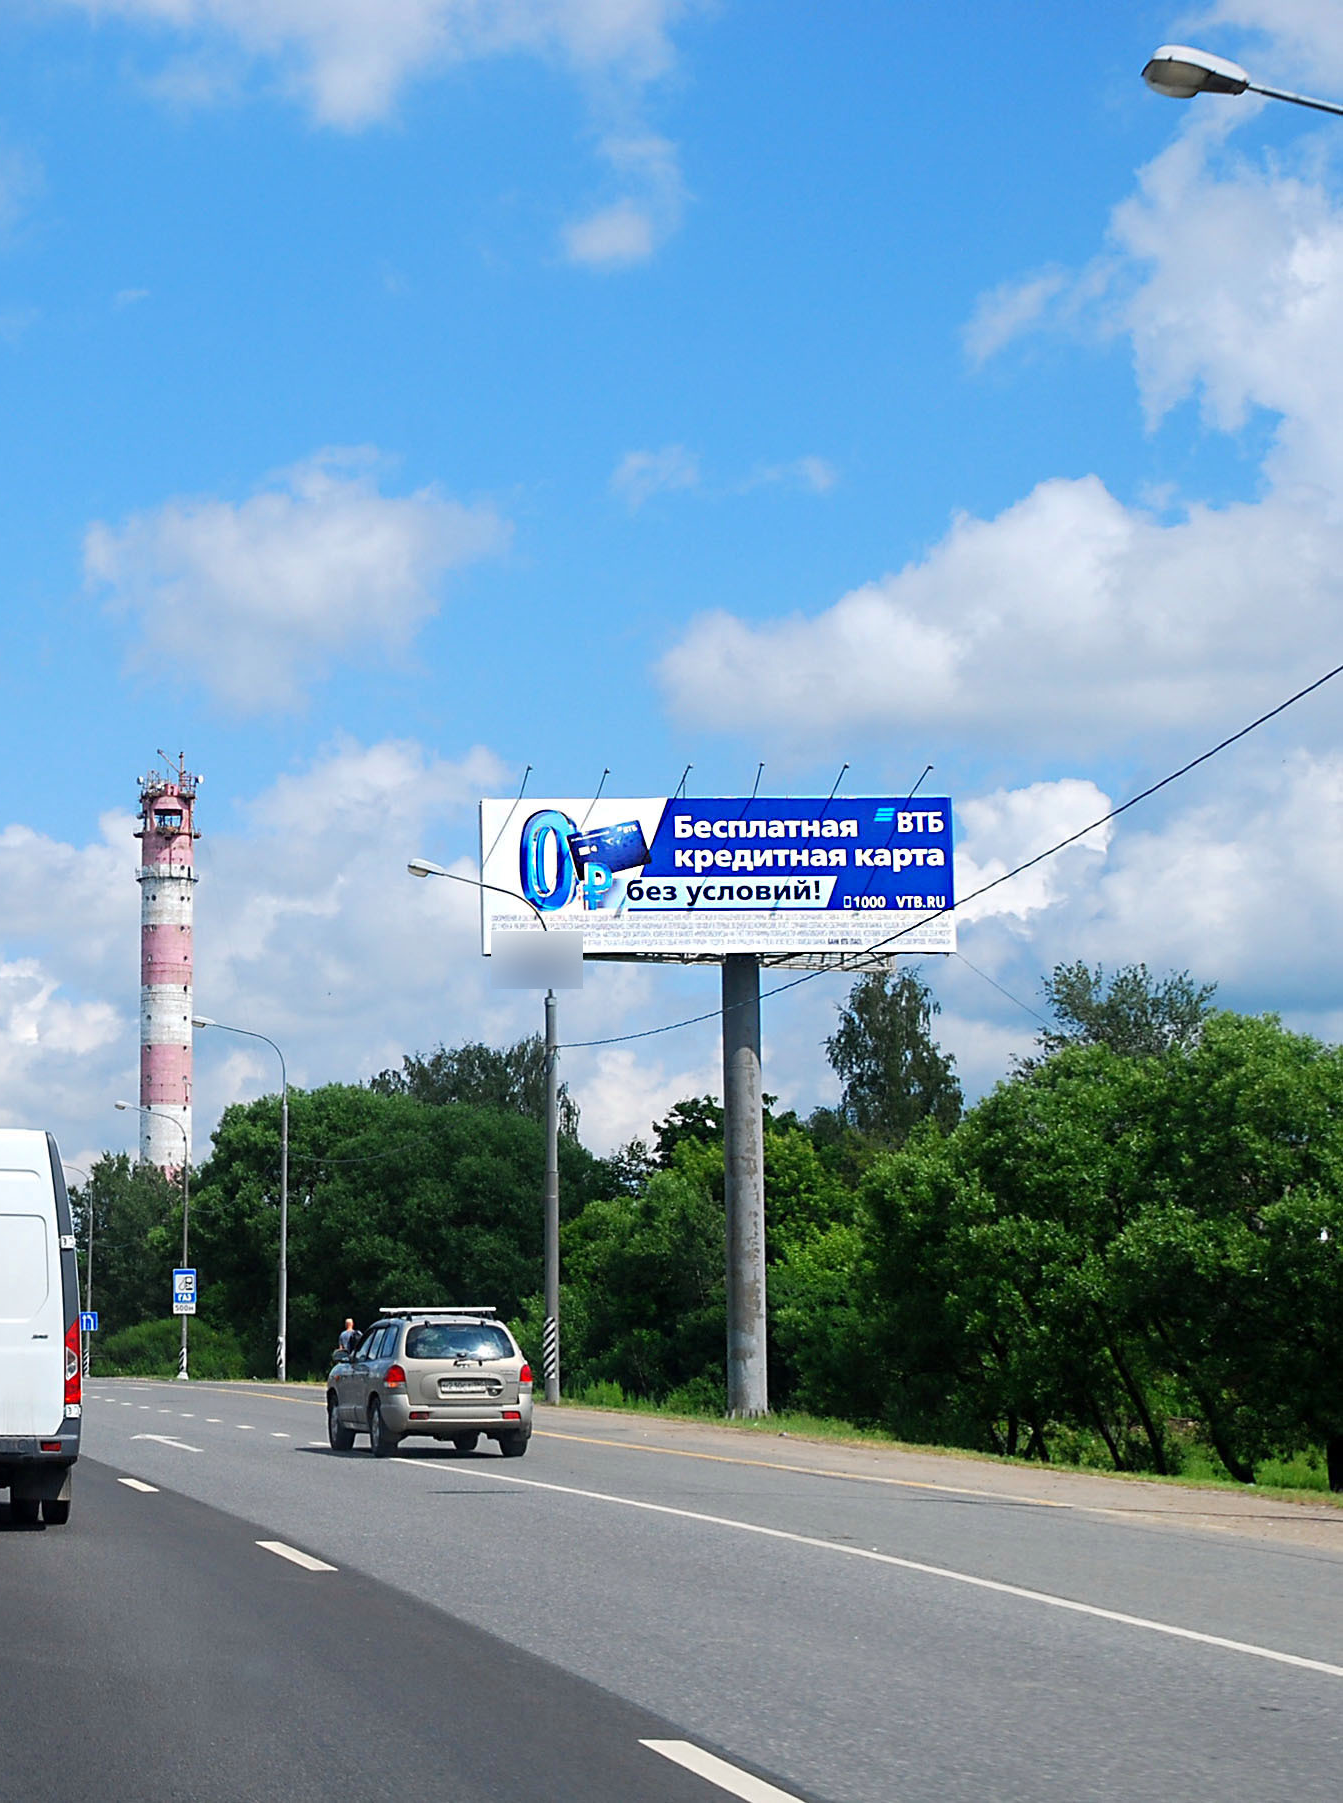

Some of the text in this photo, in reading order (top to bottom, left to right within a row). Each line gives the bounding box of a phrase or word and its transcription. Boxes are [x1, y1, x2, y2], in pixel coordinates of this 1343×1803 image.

[674, 815, 858, 839] Бесплатная
[897, 812, 944, 832] ВТБ
[674, 848, 945, 873] кредитная карта
[626, 879, 821, 907] без условий!
[896, 896, 946, 909] VTB.RU
